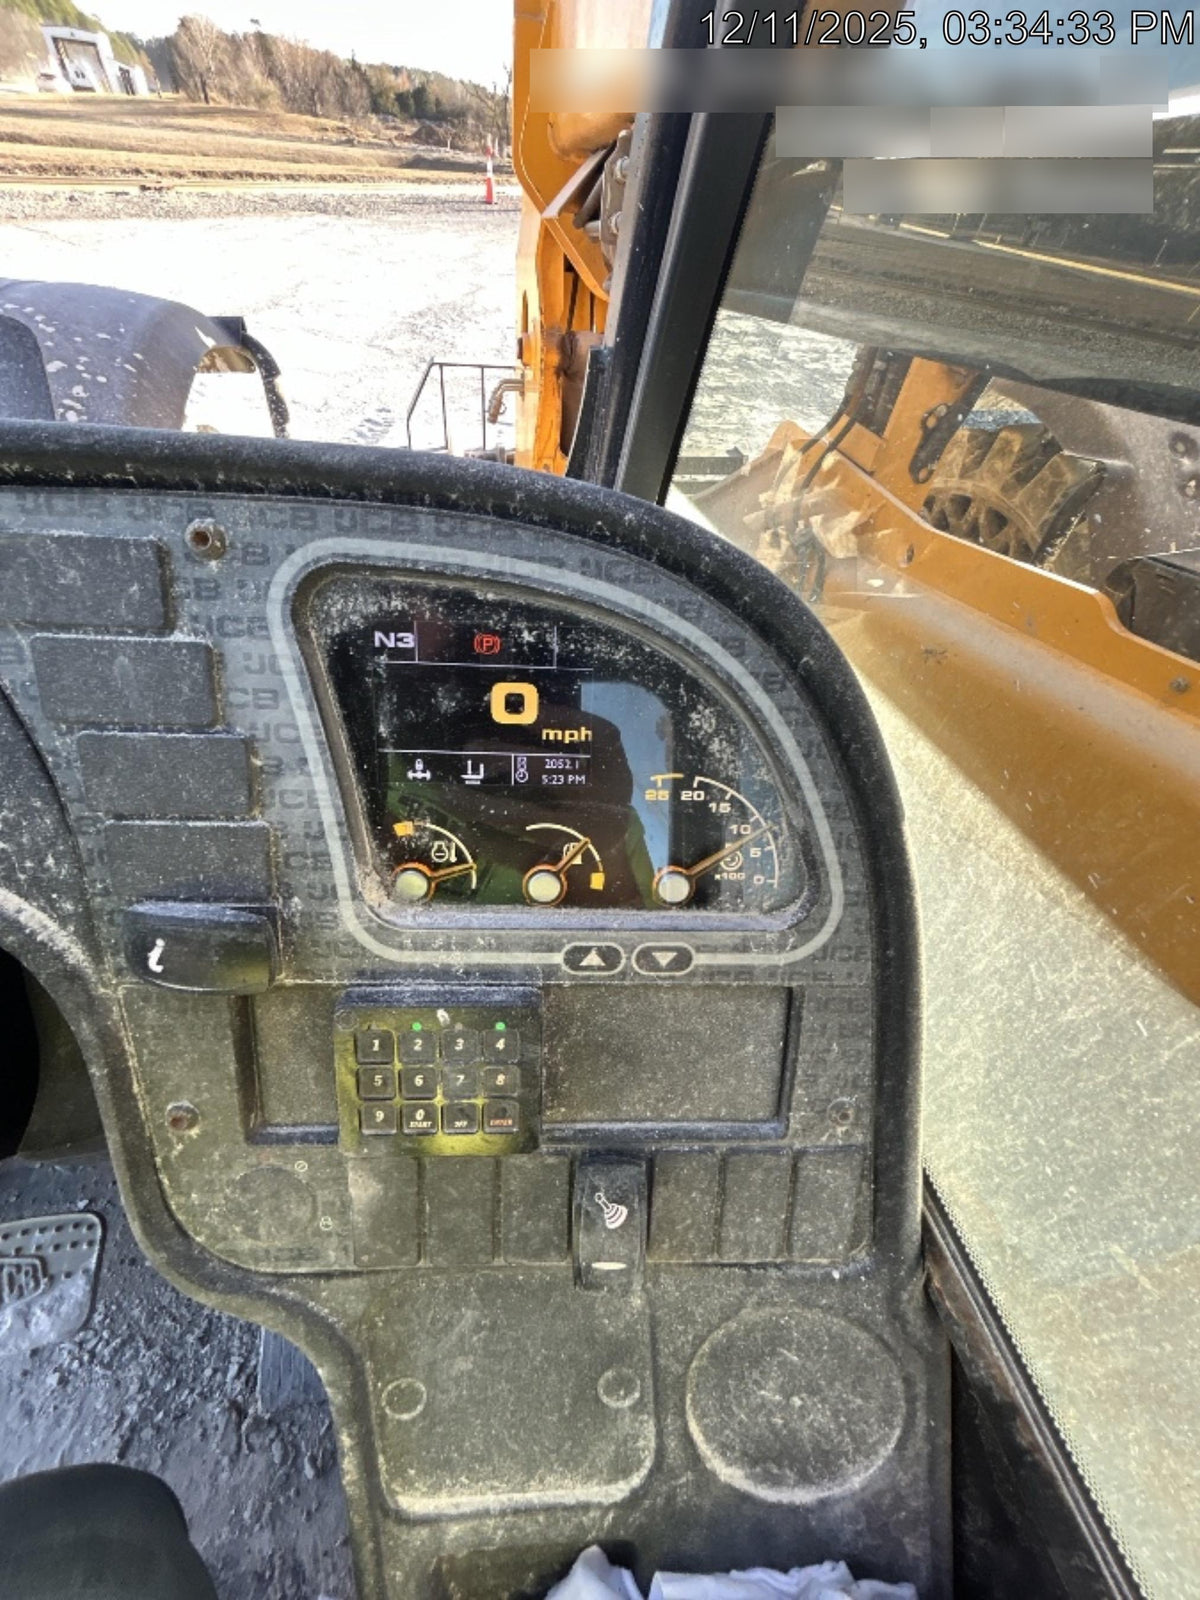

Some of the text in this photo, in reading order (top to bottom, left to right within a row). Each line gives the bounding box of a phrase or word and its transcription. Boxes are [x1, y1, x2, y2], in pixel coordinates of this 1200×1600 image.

[373, 630, 416, 649] N3
[489, 682, 540, 725] 0
[541, 727, 593, 744] mph
[541, 774, 586, 785] 5:23 PM
[681, 790, 705, 801] 20
[708, 802, 732, 814] 15
[729, 824, 752, 835] 10
[749, 847, 762, 858] 5
[752, 875, 765, 885] 0
[371, 1039, 381, 1051] 1
[413, 1038, 423, 1051] 2
[454, 1038, 465, 1051] 3
[495, 1038, 506, 1050] 4
[373, 1075, 383, 1087] 5
[414, 1075, 424, 1087] 6
[456, 1075, 465, 1086] 7
[495, 1074, 506, 1086] 8
[375, 1110, 385, 1122] 9
[415, 1108, 426, 1121] 0
